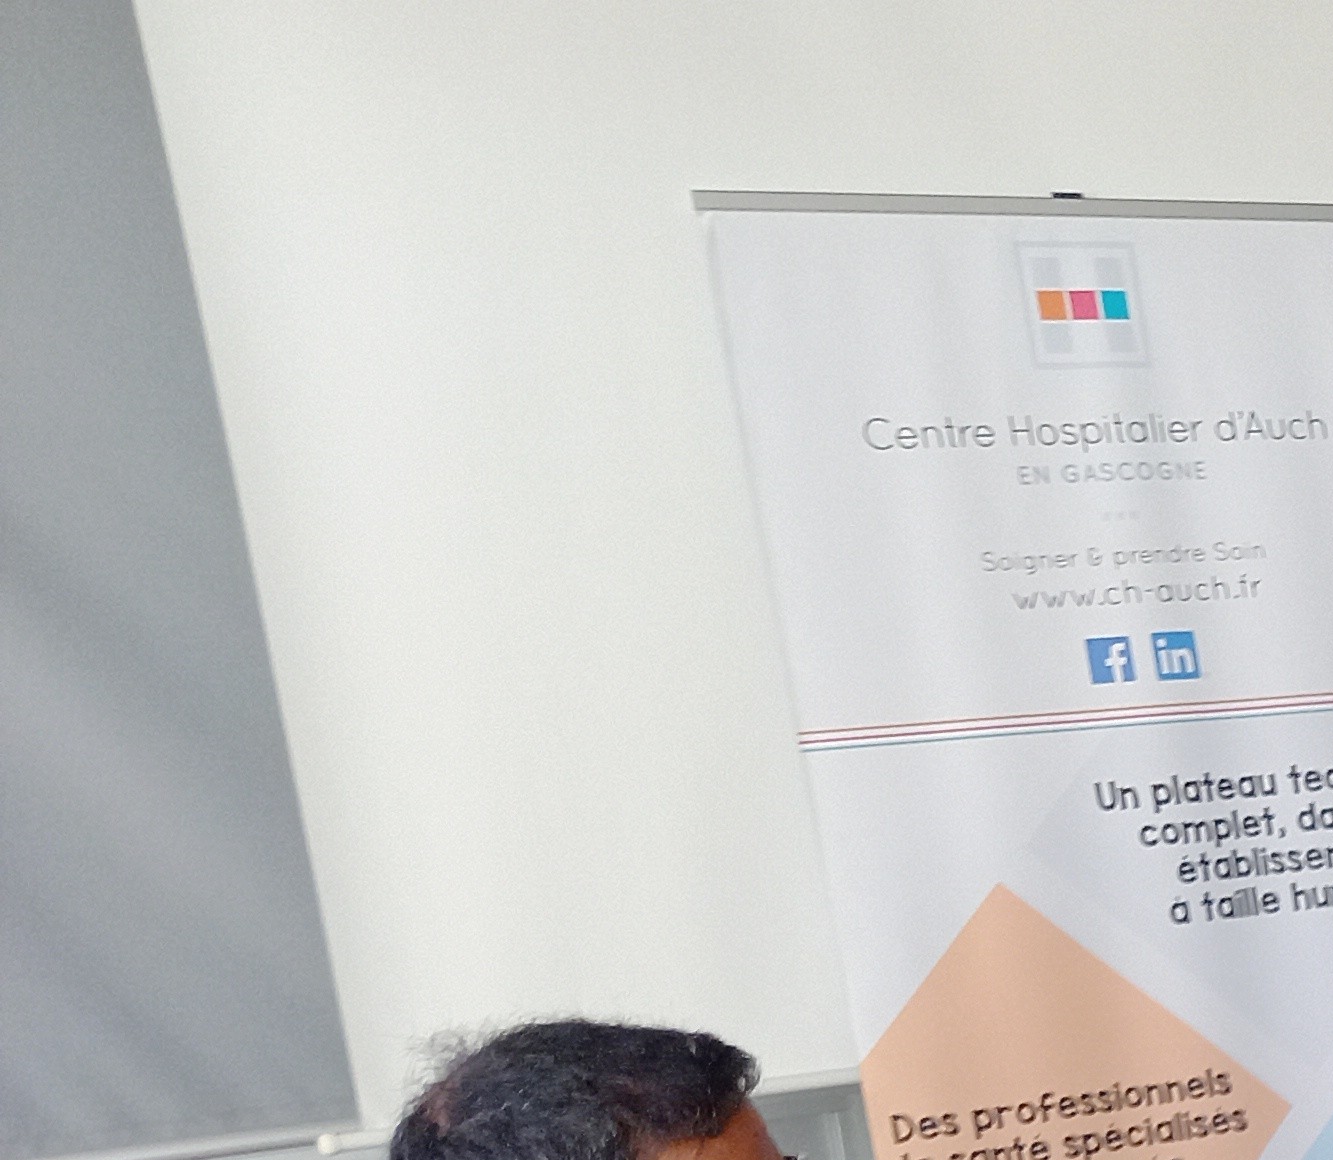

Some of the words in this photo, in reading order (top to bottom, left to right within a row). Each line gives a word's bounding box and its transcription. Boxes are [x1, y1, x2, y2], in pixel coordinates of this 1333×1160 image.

[861, 415, 997, 451] Centre
[1006, 411, 1204, 454] Hospitalier
[1213, 409, 1329, 443] d'Auch
[1016, 463, 1051, 485] EN
[1060, 460, 1209, 485] GASCOGNE
[980, 550, 1078, 576] Soigner
[1086, 546, 1104, 568] &
[1112, 543, 1207, 570] prendre
[1212, 540, 1268, 563] Soin
[1010, 573, 1263, 611] www.ch-auch.fr
[1155, 636, 1198, 675] in
[1094, 780, 1140, 813] Un
[1150, 771, 1278, 814] plateau
[1138, 804, 1288, 849] complet,
[1201, 885, 1281, 922] taille
[889, 1111, 961, 1146] Des
[972, 1068, 1234, 1139] professionnels
